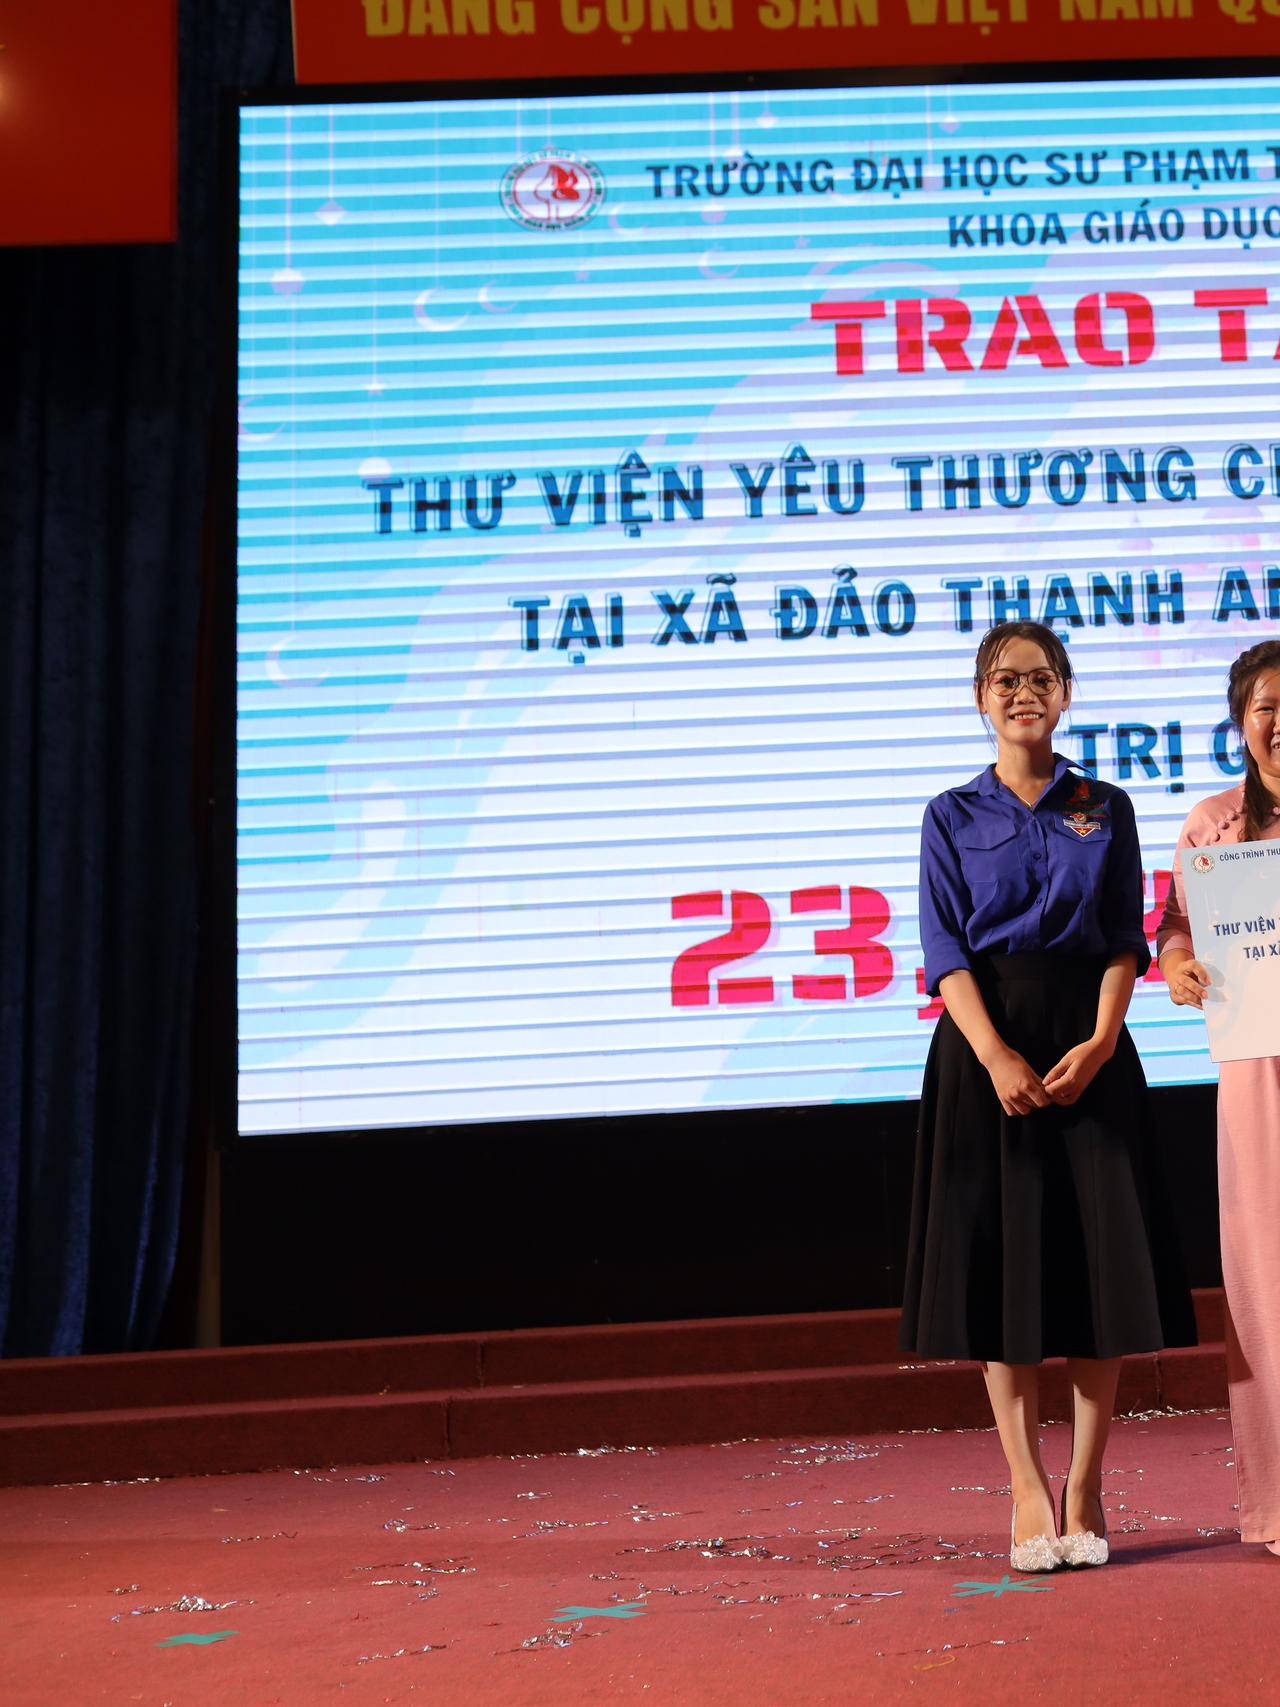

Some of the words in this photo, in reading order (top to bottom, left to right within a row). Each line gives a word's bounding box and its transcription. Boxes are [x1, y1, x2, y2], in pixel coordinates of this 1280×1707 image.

[645, 150, 835, 198] TRƯỜNG
[850, 156, 922, 199] ĐẠI
[943, 153, 1028, 196] HỌC
[1045, 150, 1107, 186] SƯ
[1123, 148, 1249, 190] PHẠM
[948, 212, 1067, 248] KHOA
[1083, 199, 1185, 244] GIÁO
[810, 291, 1156, 376] TRAO
[362, 469, 518, 534] THƯ
[536, 448, 704, 538] VIỆN
[730, 442, 866, 518] YÊU
[891, 444, 1198, 512] THƯƠNG
[508, 591, 625, 664] TẠI
[650, 572, 748, 647] XÃ
[769, 563, 916, 641] ĐẢO
[940, 567, 1186, 643] THẠNH
[1065, 720, 1185, 793] TRỊ
[1219, 851, 1240, 862] CÔNG
[1241, 848, 1265, 861] TRÌNH
[1213, 922, 1241, 936] THƯ
[1244, 916, 1276, 935] VIỆN
[1243, 946, 1265, 961] TẠI
